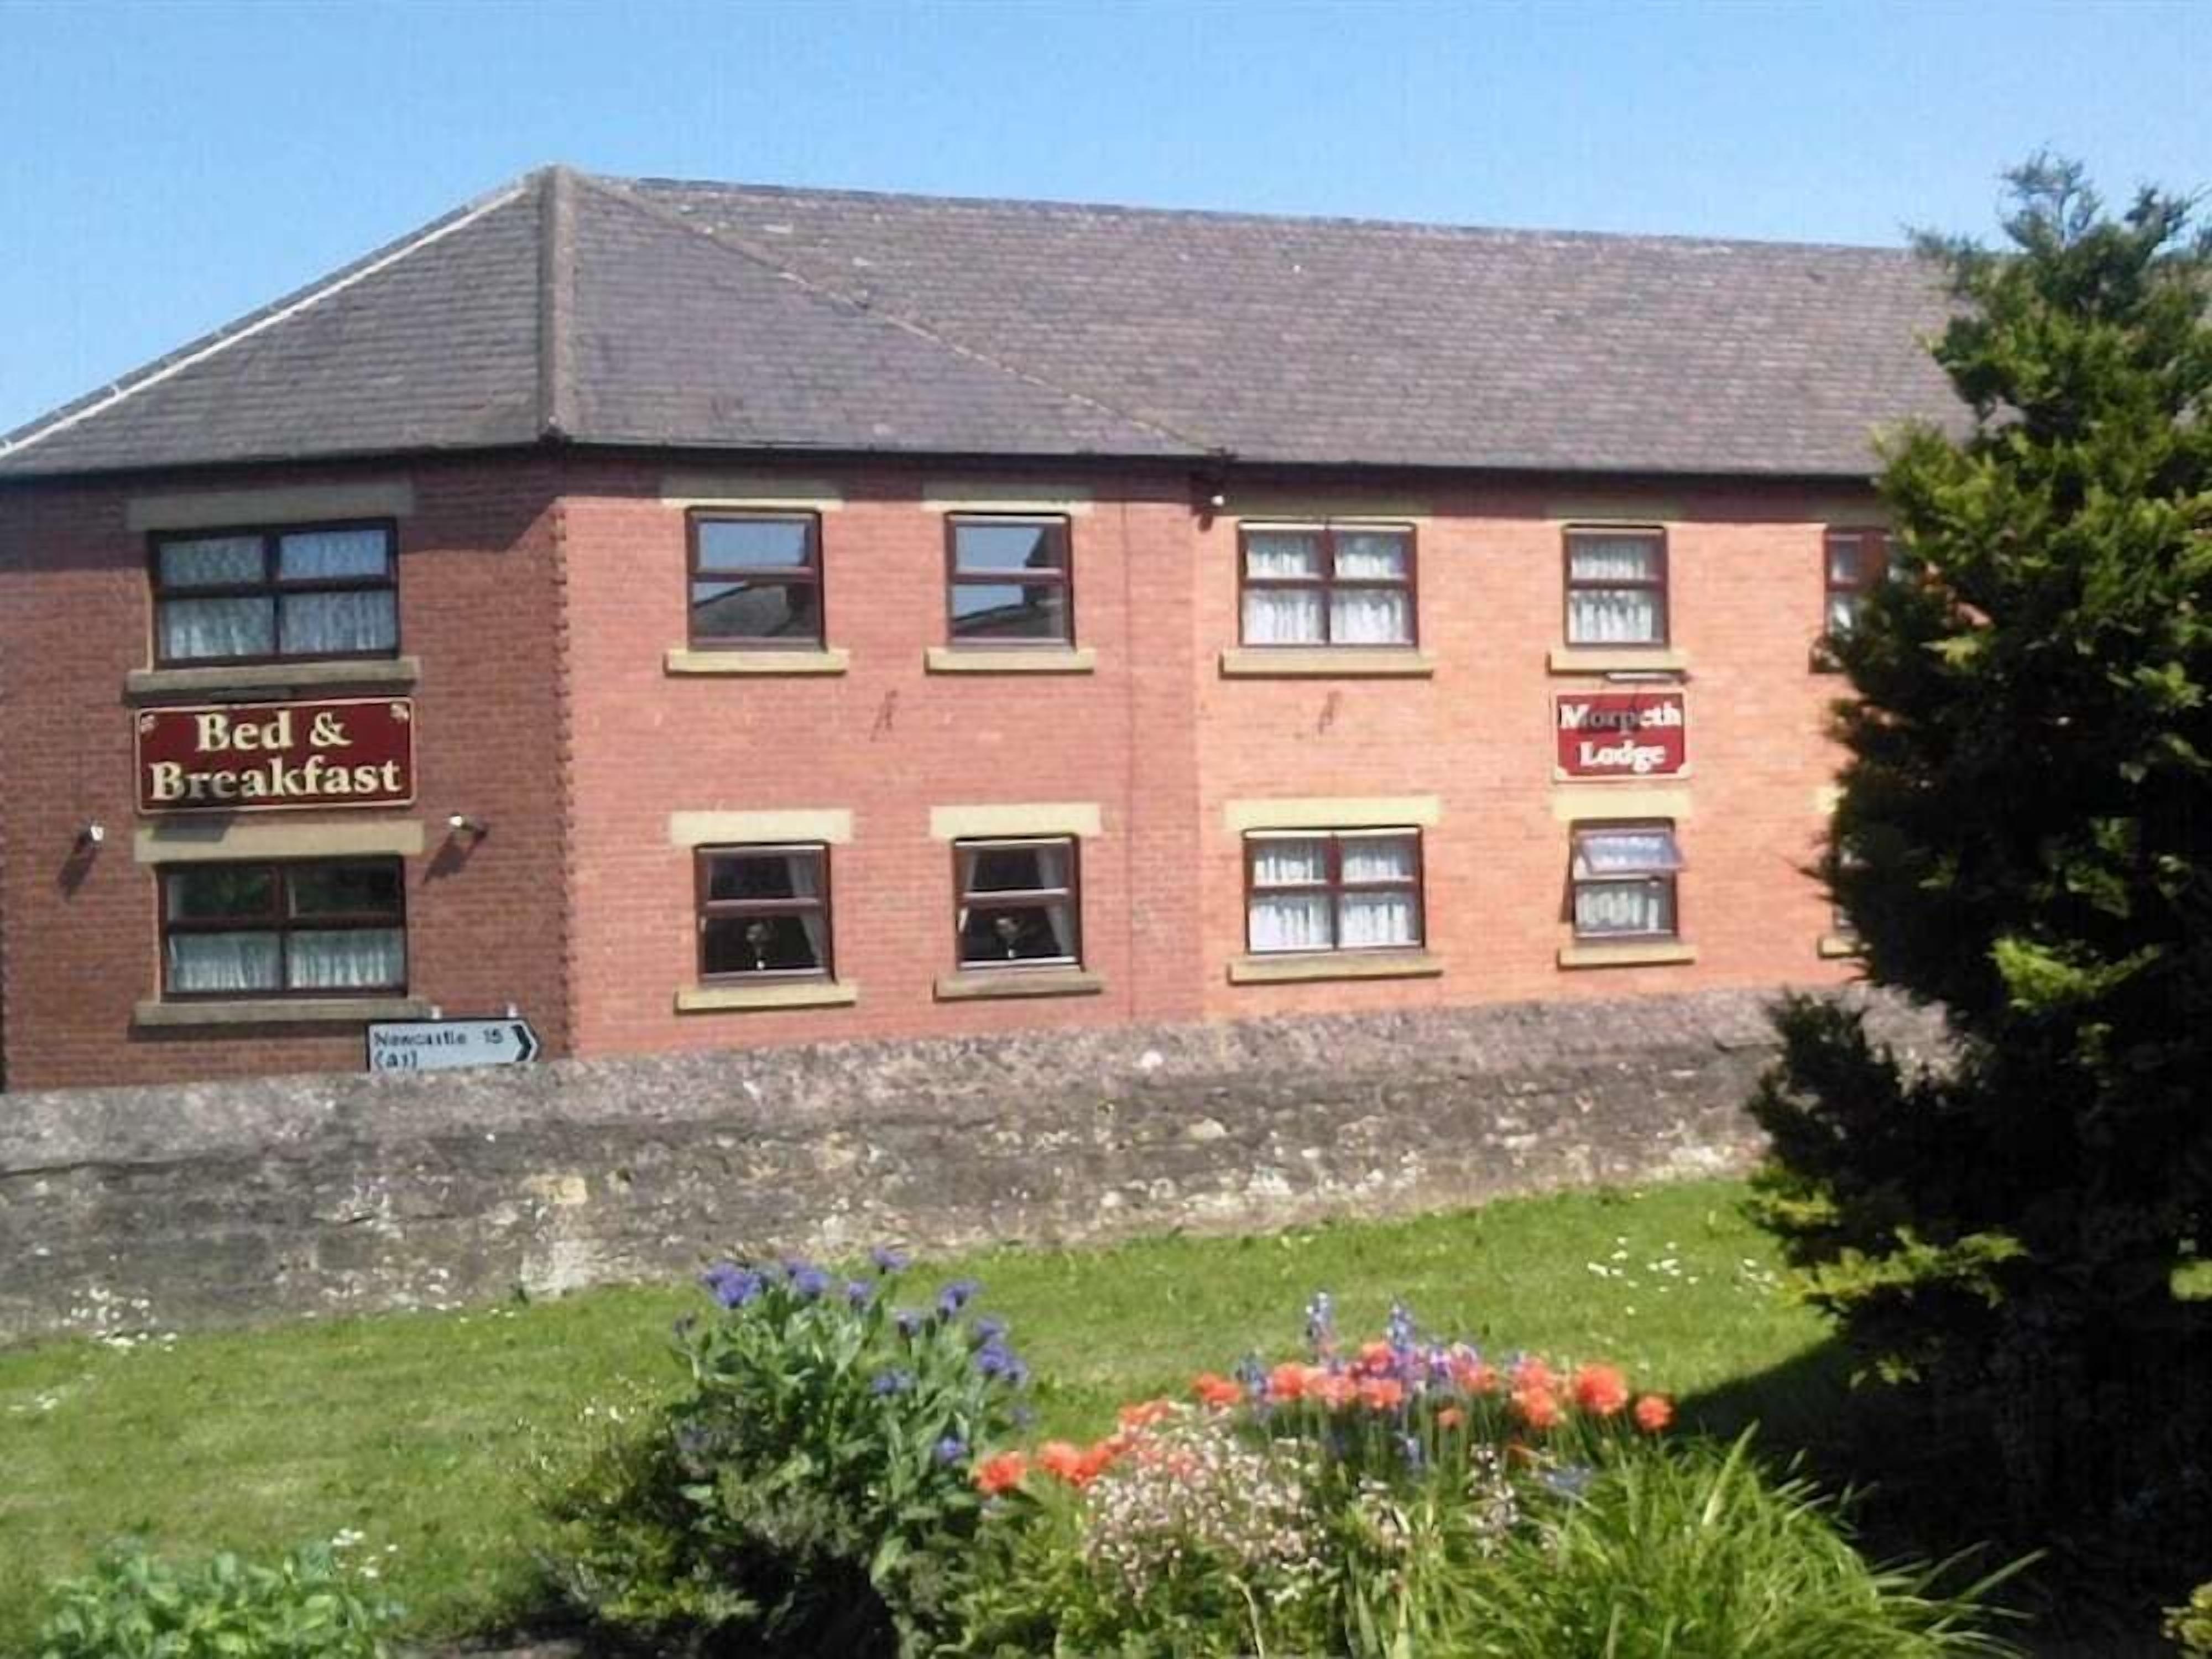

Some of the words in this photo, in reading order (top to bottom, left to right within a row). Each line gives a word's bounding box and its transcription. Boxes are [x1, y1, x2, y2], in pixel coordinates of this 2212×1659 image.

[195, 711, 294, 752] Bed
[310, 712, 352, 747] &
[1560, 701, 1682, 735] Morpeth
[1580, 739, 1666, 772] Lodge
[150, 755, 403, 800] Breakfast
